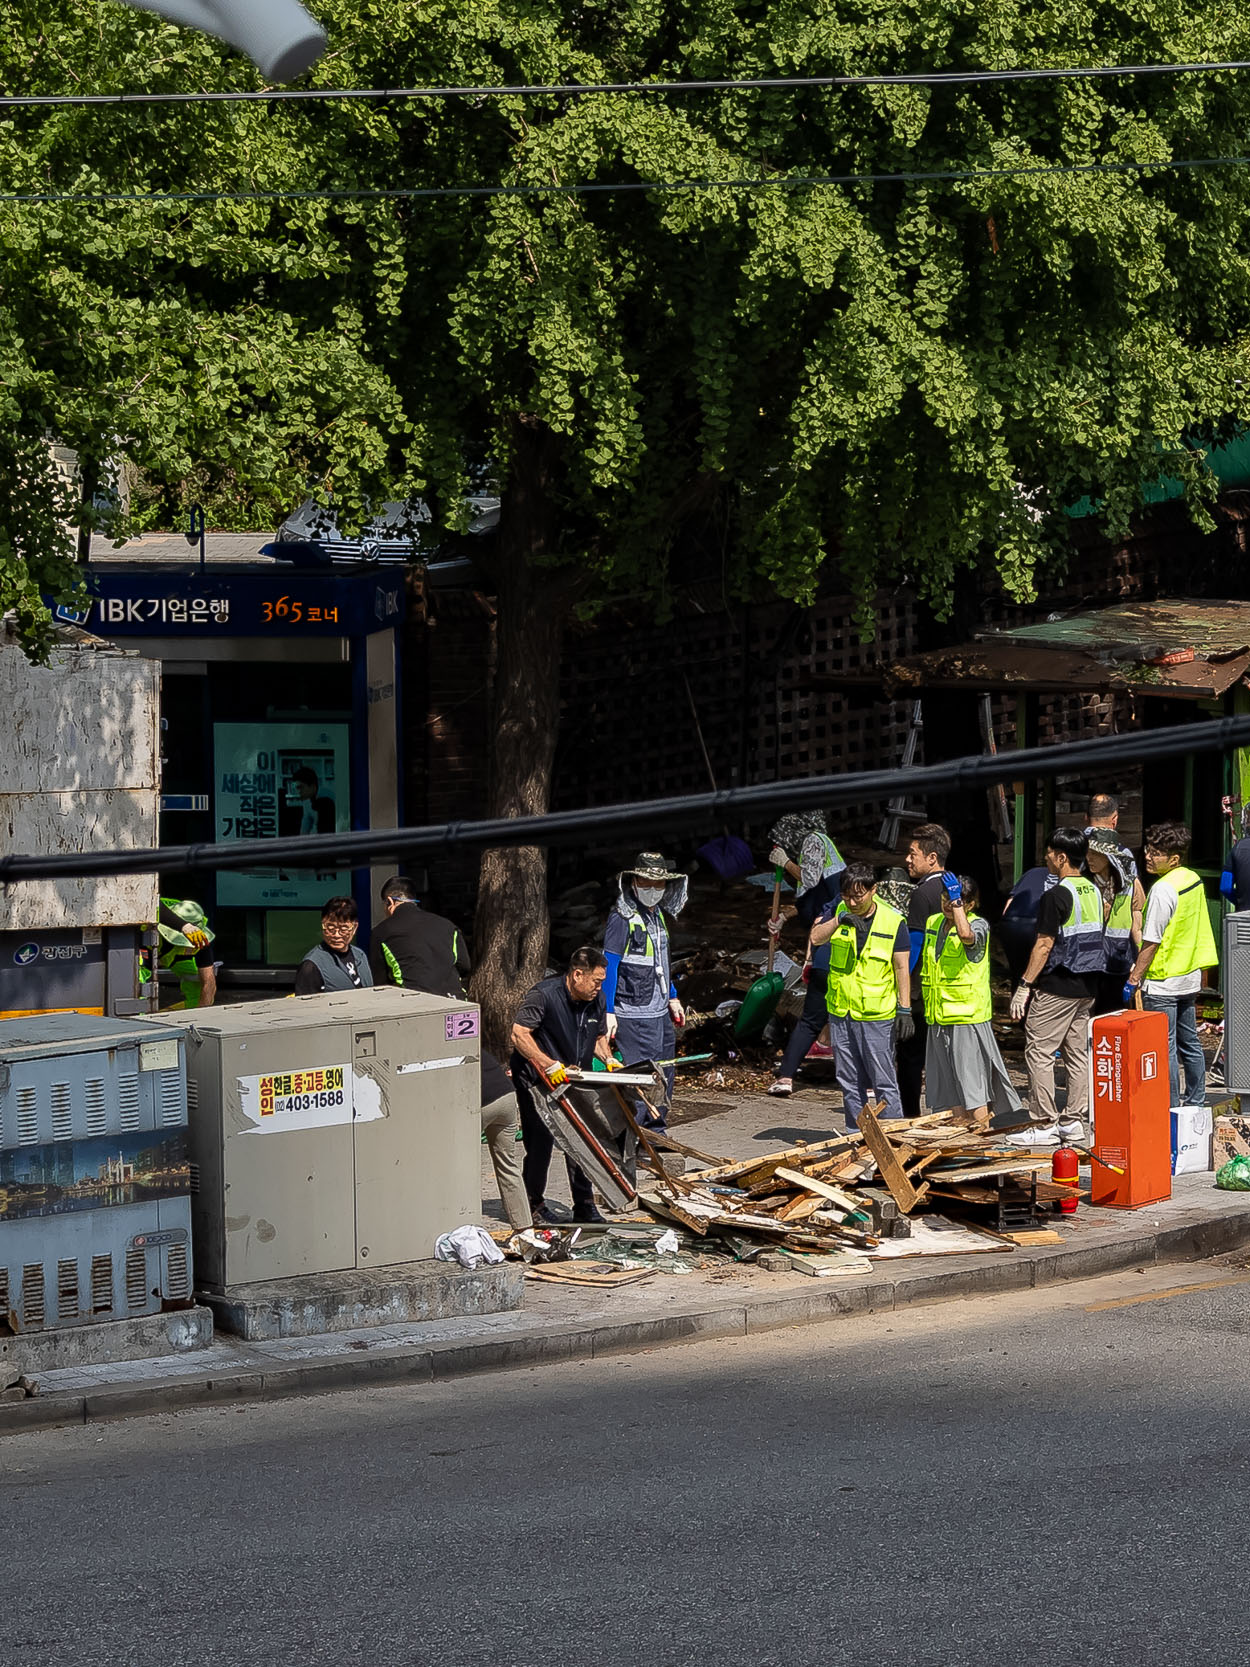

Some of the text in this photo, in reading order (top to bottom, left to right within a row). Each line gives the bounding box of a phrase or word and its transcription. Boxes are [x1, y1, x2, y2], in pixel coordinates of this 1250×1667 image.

[261, 595, 302, 624] 365
[307, 605, 339, 624] 코너
[257, 751, 276, 771] 이
[221, 773, 276, 794] 세상에
[239, 796, 277, 817] 작은
[222, 817, 277, 839] 기업은
[41, 944, 87, 960] 광진구
[457, 1019, 475, 1036] 2
[1095, 1035, 1114, 1102] 소화기
[1114, 1035, 1123, 1103] Fire Extinguisher
[260, 1077, 274, 1116] 성인
